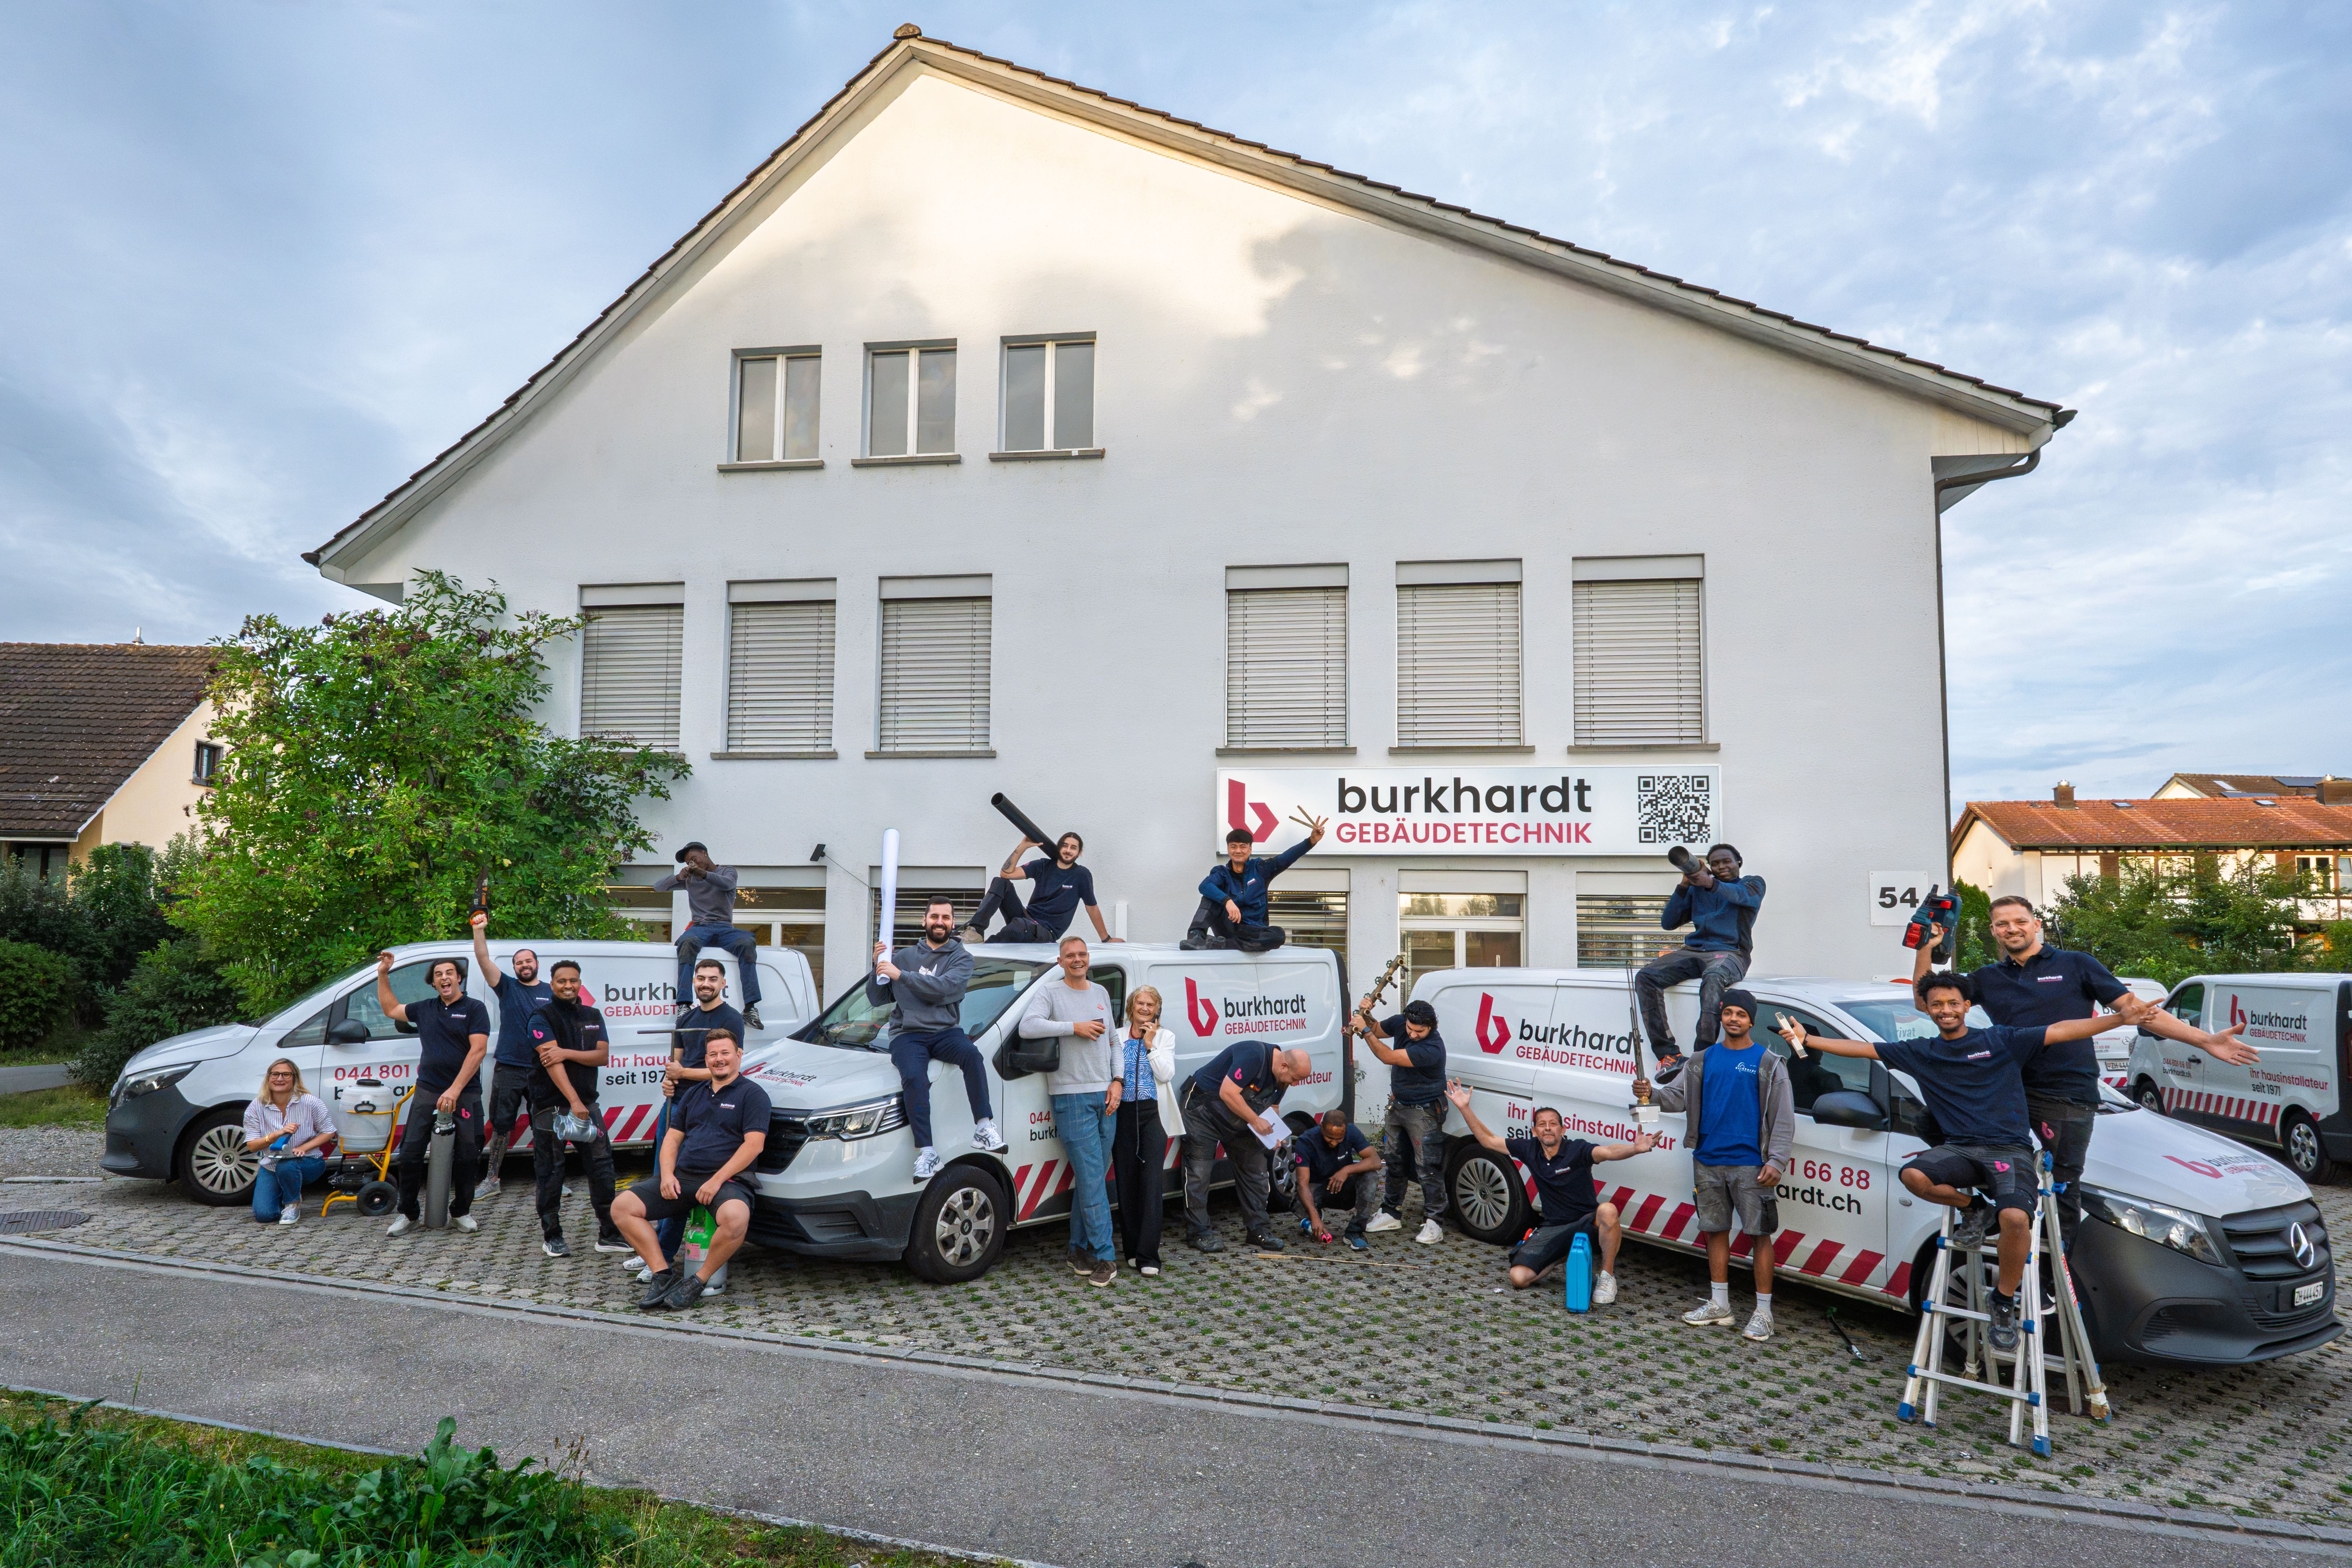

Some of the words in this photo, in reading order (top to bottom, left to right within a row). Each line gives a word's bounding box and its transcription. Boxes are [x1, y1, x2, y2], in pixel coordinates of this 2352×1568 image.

[1338, 777, 1591, 814] burkhardt
[1336, 818, 1592, 844] GEBÄUDETECHNIK
[1878, 887, 1919, 908] 54
[605, 982, 729, 1002] burkht
[1224, 994, 1306, 1018] burkhardt
[1225, 1018, 1307, 1035] GEBÄUDETECHNIK
[2251, 1010, 2307, 1030] burkhardt
[334, 1066, 372, 1080] 044
[379, 1064, 409, 1079] 801
[606, 1071, 636, 1086] seit
[641, 1070, 666, 1084] 197
[763, 1069, 817, 1082] burkhardt
[2249, 1067, 2259, 1079] ihr
[2261, 1070, 2328, 1091] hausinstallateur
[2252, 1082, 2265, 1092] seit
[2267, 1084, 2281, 1096] 1971
[1030, 1110, 1051, 1124] 044
[1507, 1101, 1527, 1120] ihr
[1803, 1160, 1831, 1182] 66
[1840, 1167, 1870, 1190] 88
[1776, 1184, 1861, 1215] ardt.ch
